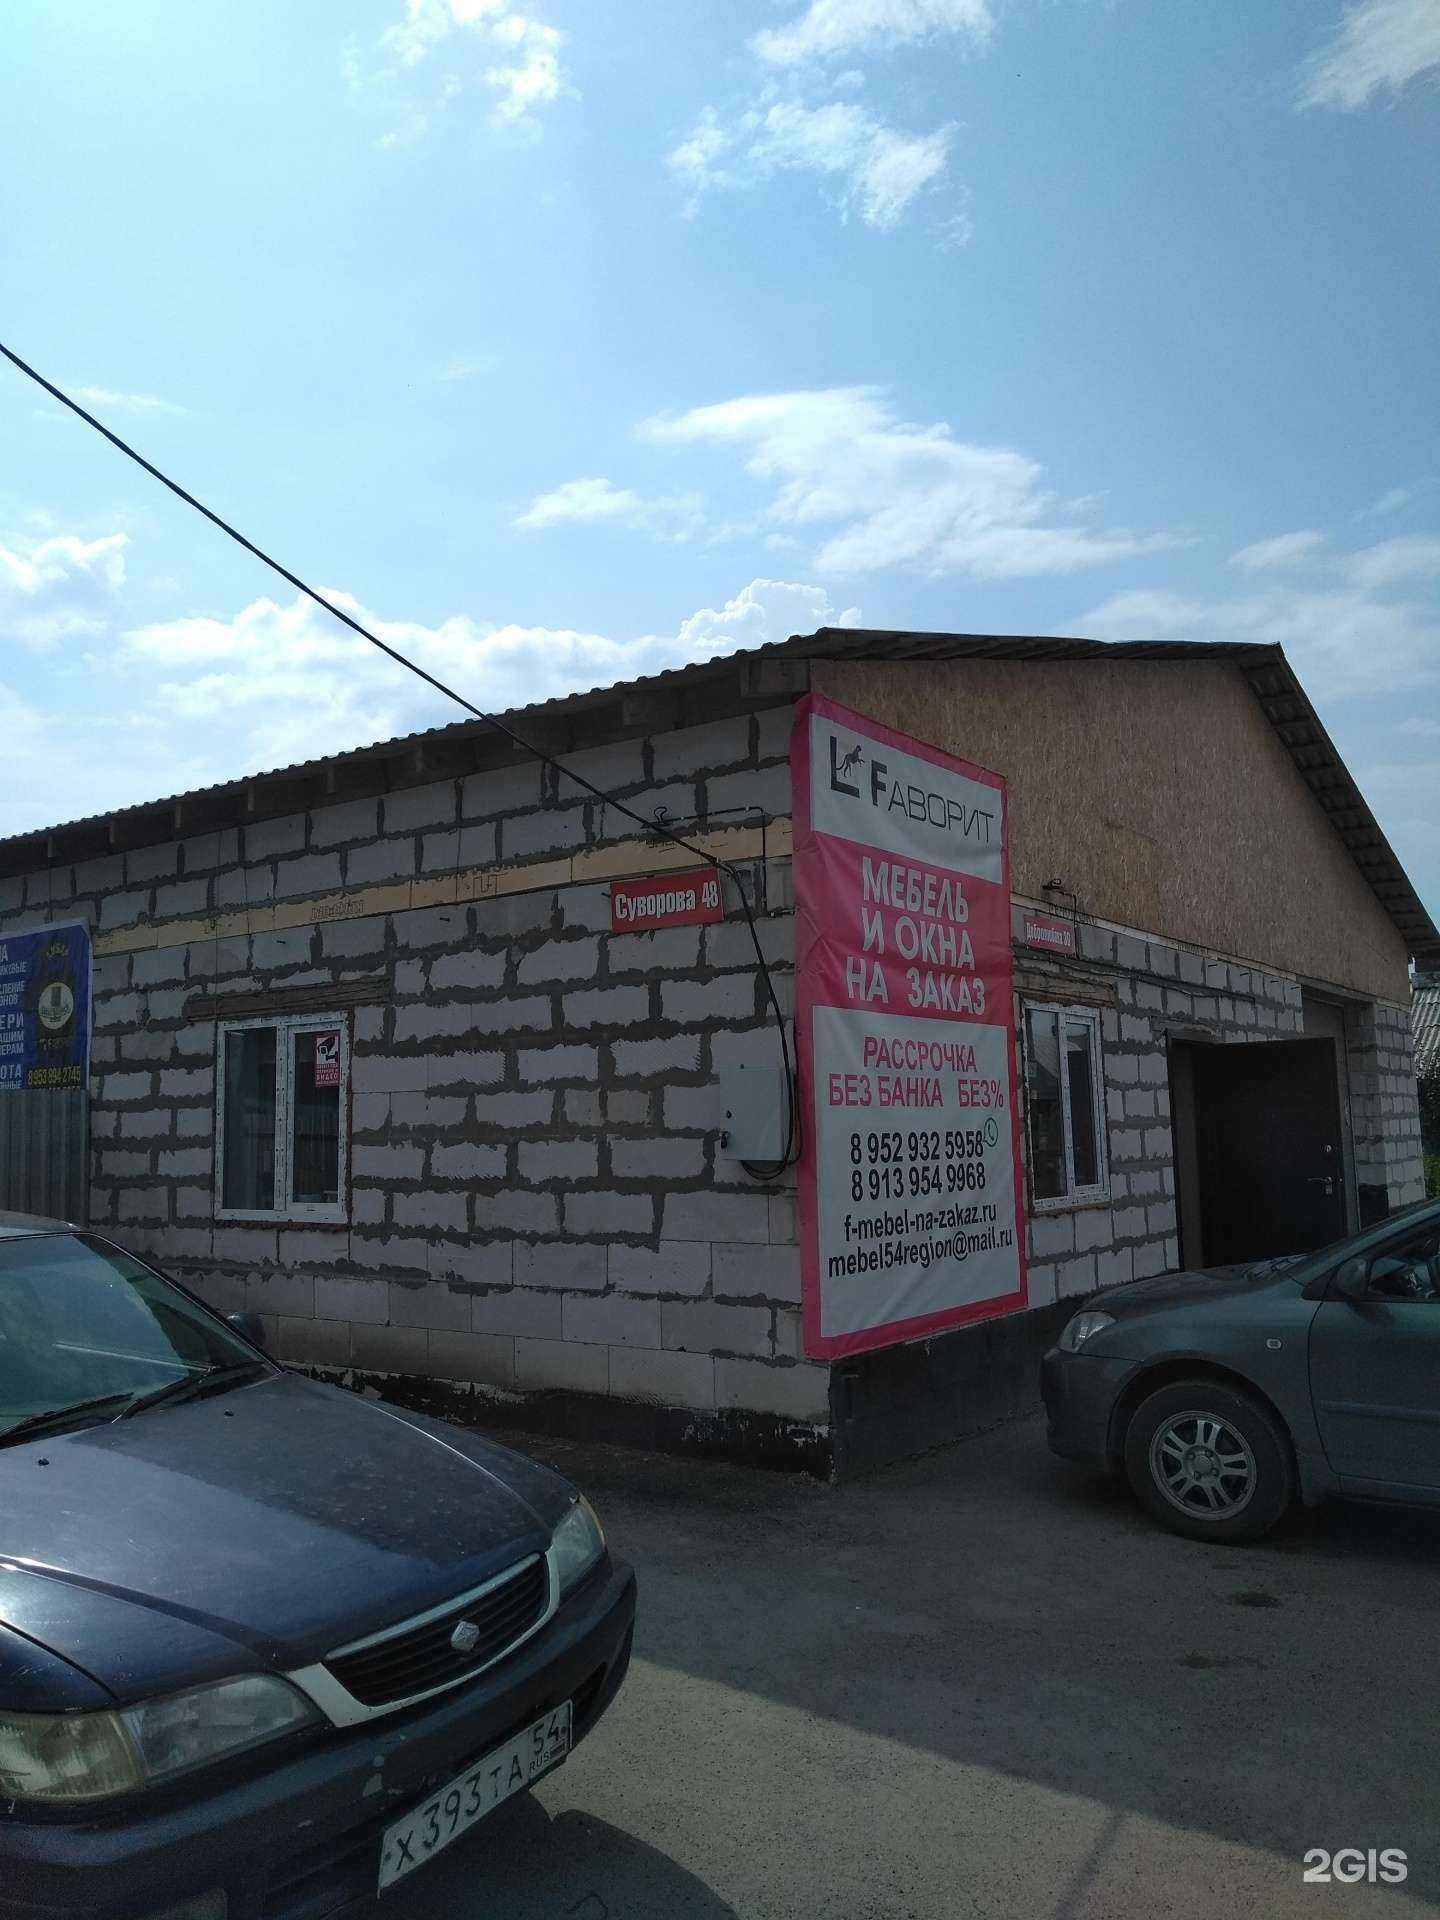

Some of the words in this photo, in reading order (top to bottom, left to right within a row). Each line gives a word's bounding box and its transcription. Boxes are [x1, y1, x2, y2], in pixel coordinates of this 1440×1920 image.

[615, 889, 696, 921] Суворова
[702, 880, 719, 908] 48
[862, 855, 969, 923] МЕБЕЛЬ
[861, 906, 885, 954] И
[895, 915, 976, 971] ОКНА
[846, 956, 889, 1004] НА
[906, 966, 986, 1015] ЗАКАЗ
[863, 1036, 978, 1073] РАССРОЧКА
[829, 1073, 873, 1107] БЕЗ
[878, 1075, 944, 1108] БАНКА
[958, 1079, 1004, 1109] БЕЗ%
[850, 1133, 862, 1165] 8
[867, 1132, 903, 1163] 952
[908, 1131, 940, 1161] 932
[945, 1130, 984, 1159] 5958
[851, 1169, 863, 1201] 8
[868, 1167, 904, 1200] 913
[909, 1164, 942, 1196] 954
[946, 1161, 986, 1192] 9968
[844, 1203, 997, 1242] f-mebel-na-zakaz.ru
[828, 1226, 1013, 1278] mebel54region@mail.ru
[532, 1713, 560, 1756] 54
[529, 1751, 551, 1777] RUS
